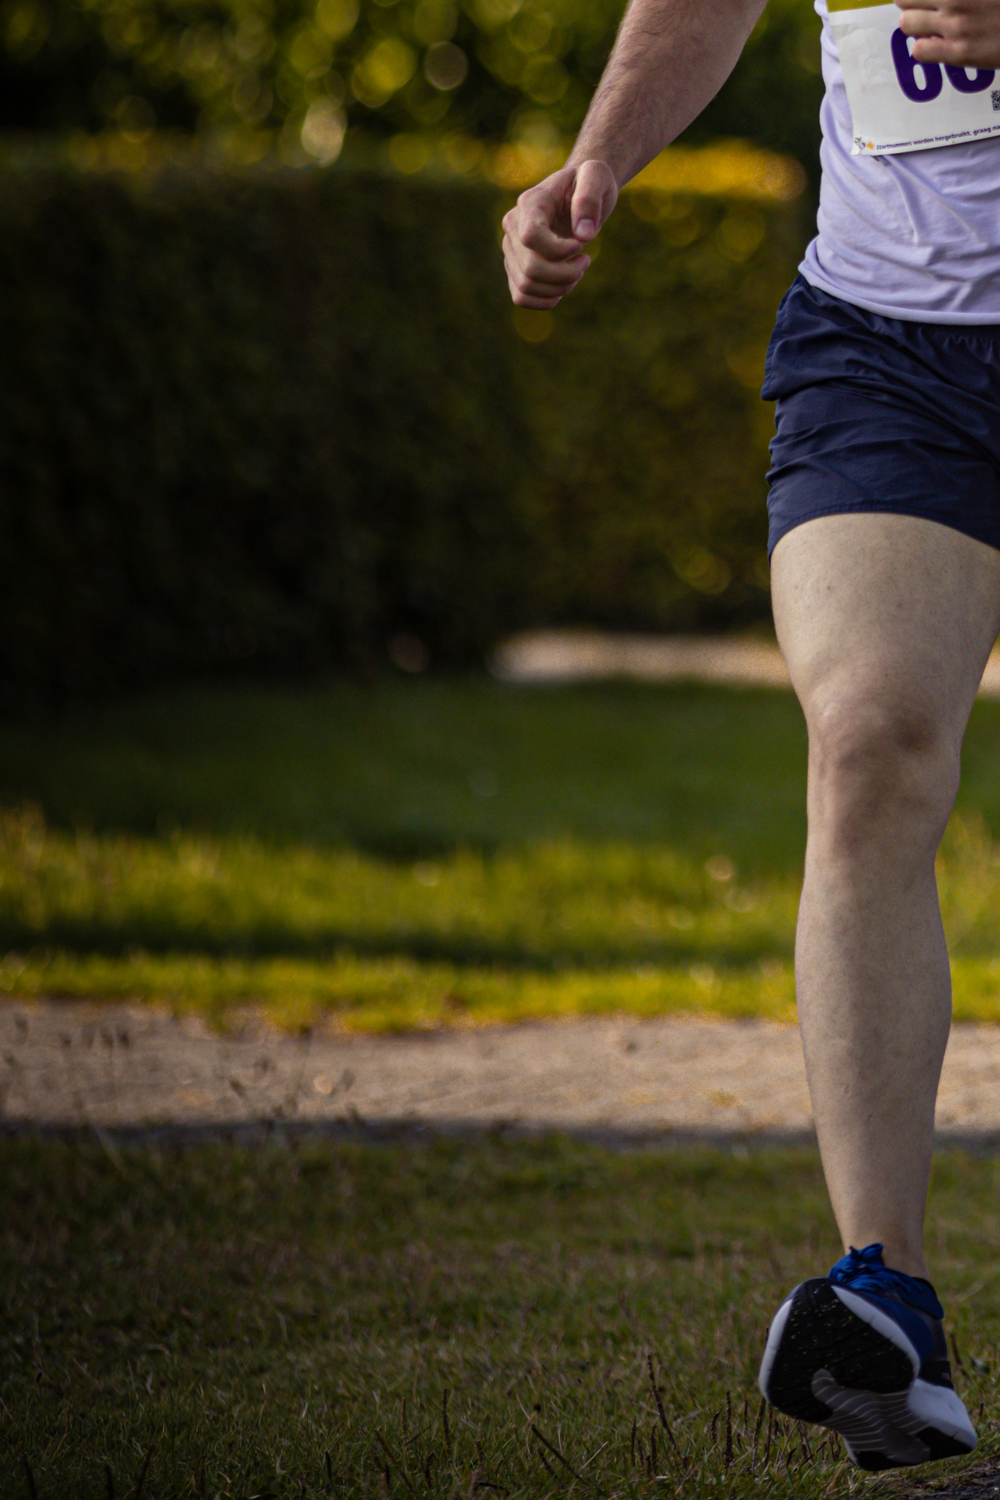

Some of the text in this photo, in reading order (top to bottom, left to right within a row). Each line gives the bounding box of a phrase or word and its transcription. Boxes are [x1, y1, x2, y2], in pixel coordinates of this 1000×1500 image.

[876, 141, 912, 150] Startnummers
[913, 138, 934, 146] worden
[935, 131, 972, 141] hergebruikt,
[973, 127, 991, 136] graag
